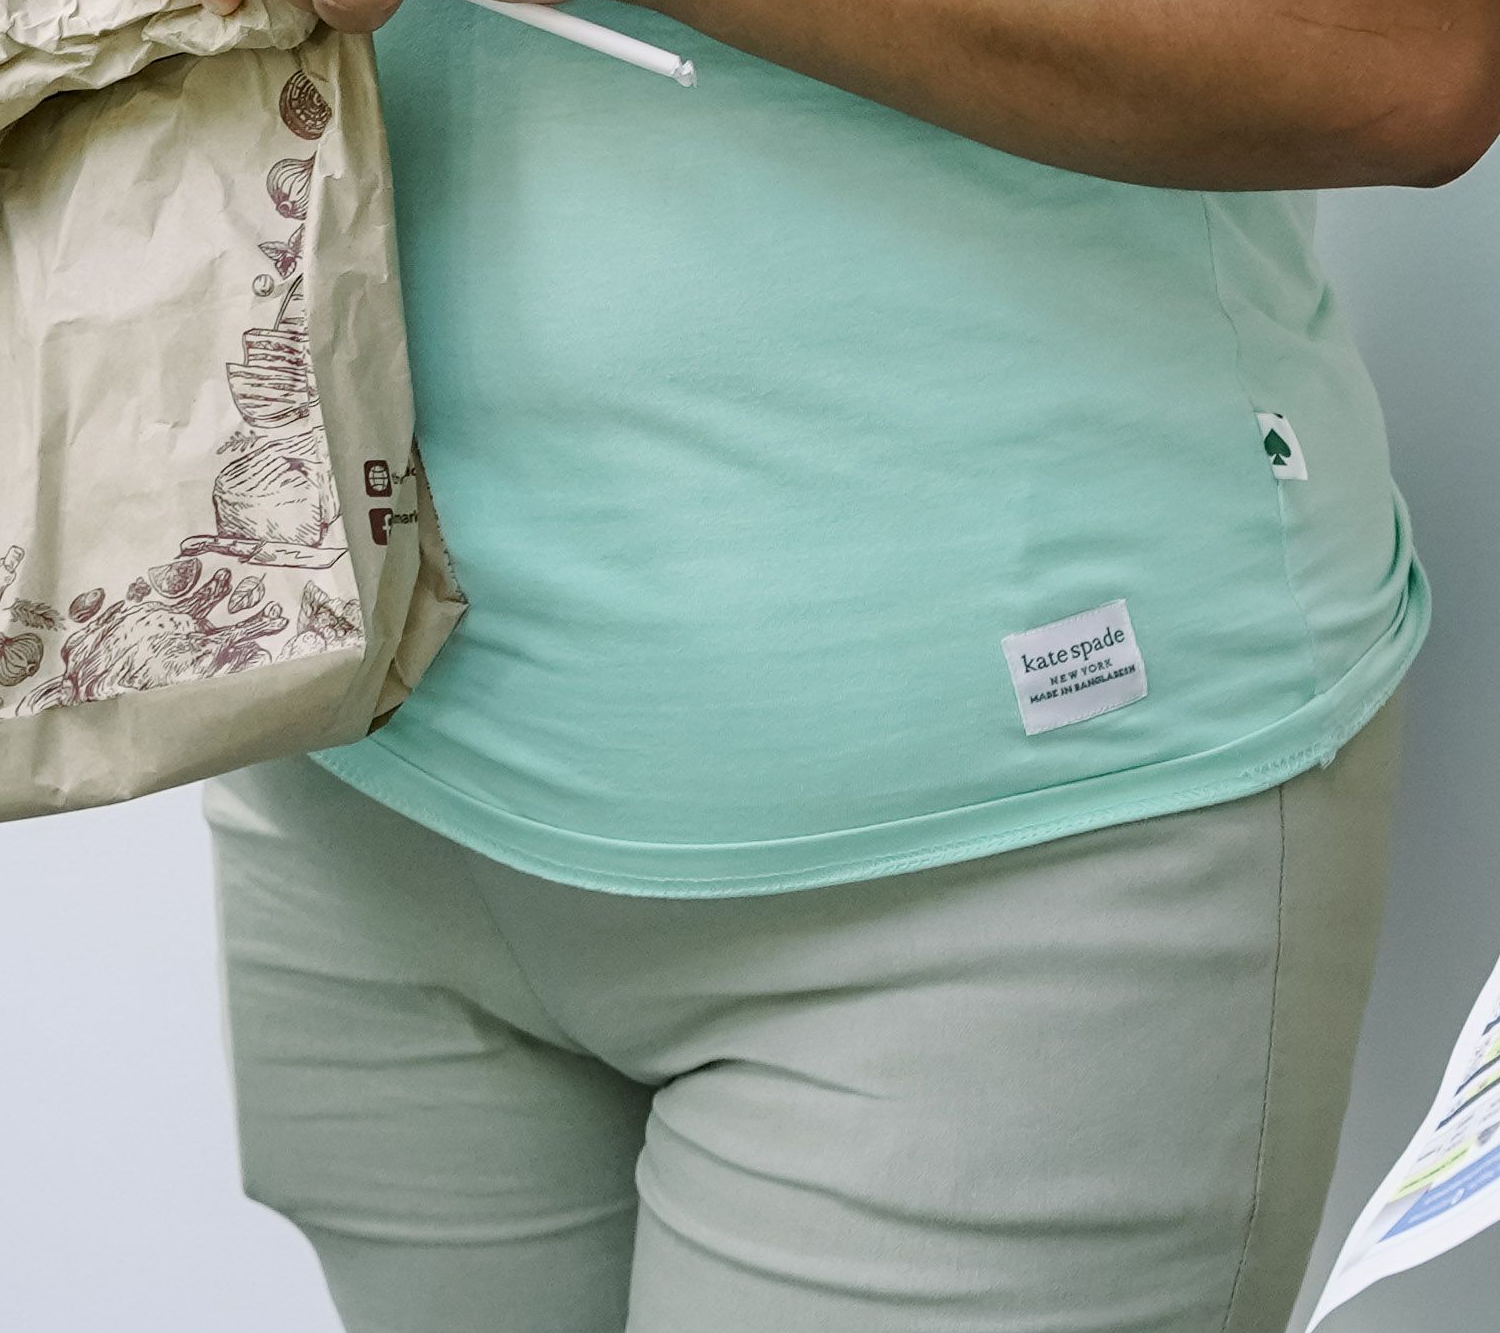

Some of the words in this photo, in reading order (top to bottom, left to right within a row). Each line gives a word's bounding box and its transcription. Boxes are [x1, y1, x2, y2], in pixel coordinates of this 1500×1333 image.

[1021, 649, 1069, 673] kate
[1070, 626, 1126, 662] spade
[1049, 669, 1078, 686] NEW
[1080, 658, 1113, 676] YORK
[1029, 689, 1059, 704] MADE
[1060, 685, 1073, 696] IN
